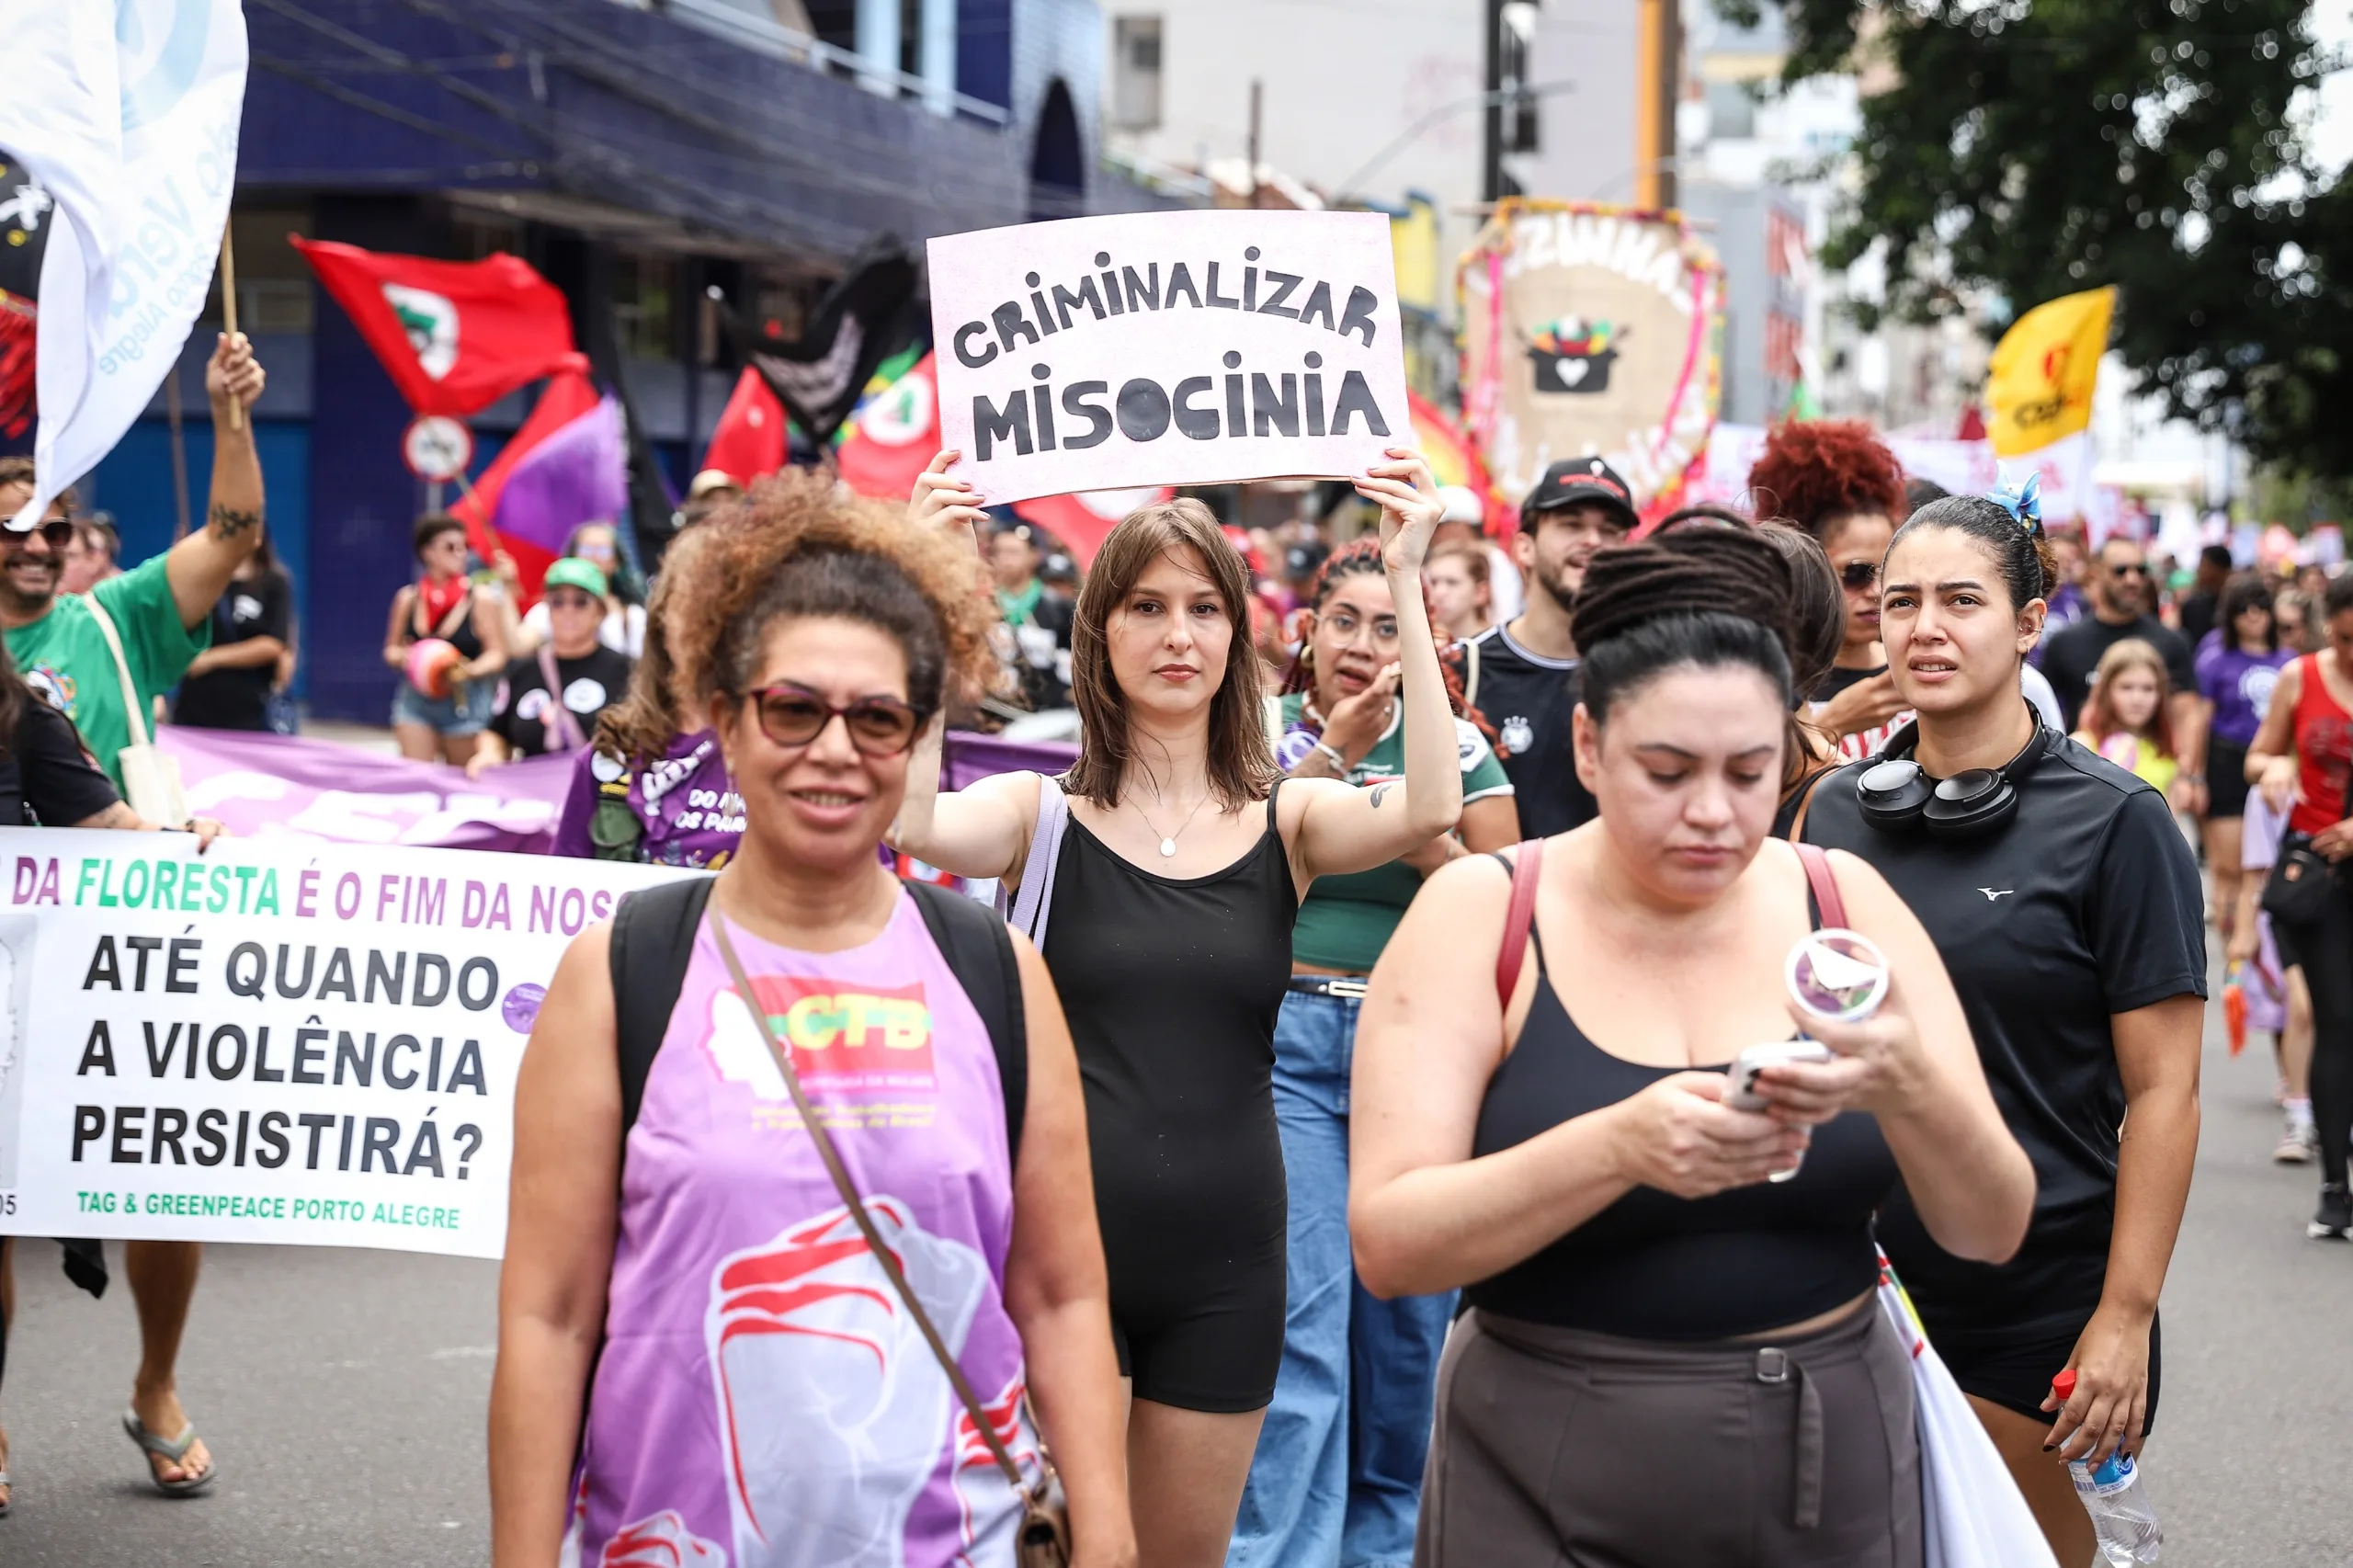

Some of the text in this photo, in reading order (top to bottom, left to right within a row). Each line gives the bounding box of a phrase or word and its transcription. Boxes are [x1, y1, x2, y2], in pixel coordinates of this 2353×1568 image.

[12, 856, 629, 937] DA FLORESTA É O FIM DA NOS
[83, 926, 499, 1012] ATÉ QUANDO
[77, 1016, 487, 1096] A VIOLÊNCIA
[787, 993, 929, 1050] CTB
[71, 1105, 483, 1180] PERSISTIRÁ?
[77, 1191, 460, 1230] TAG & GREENPEACE PORTO ALEGRE
